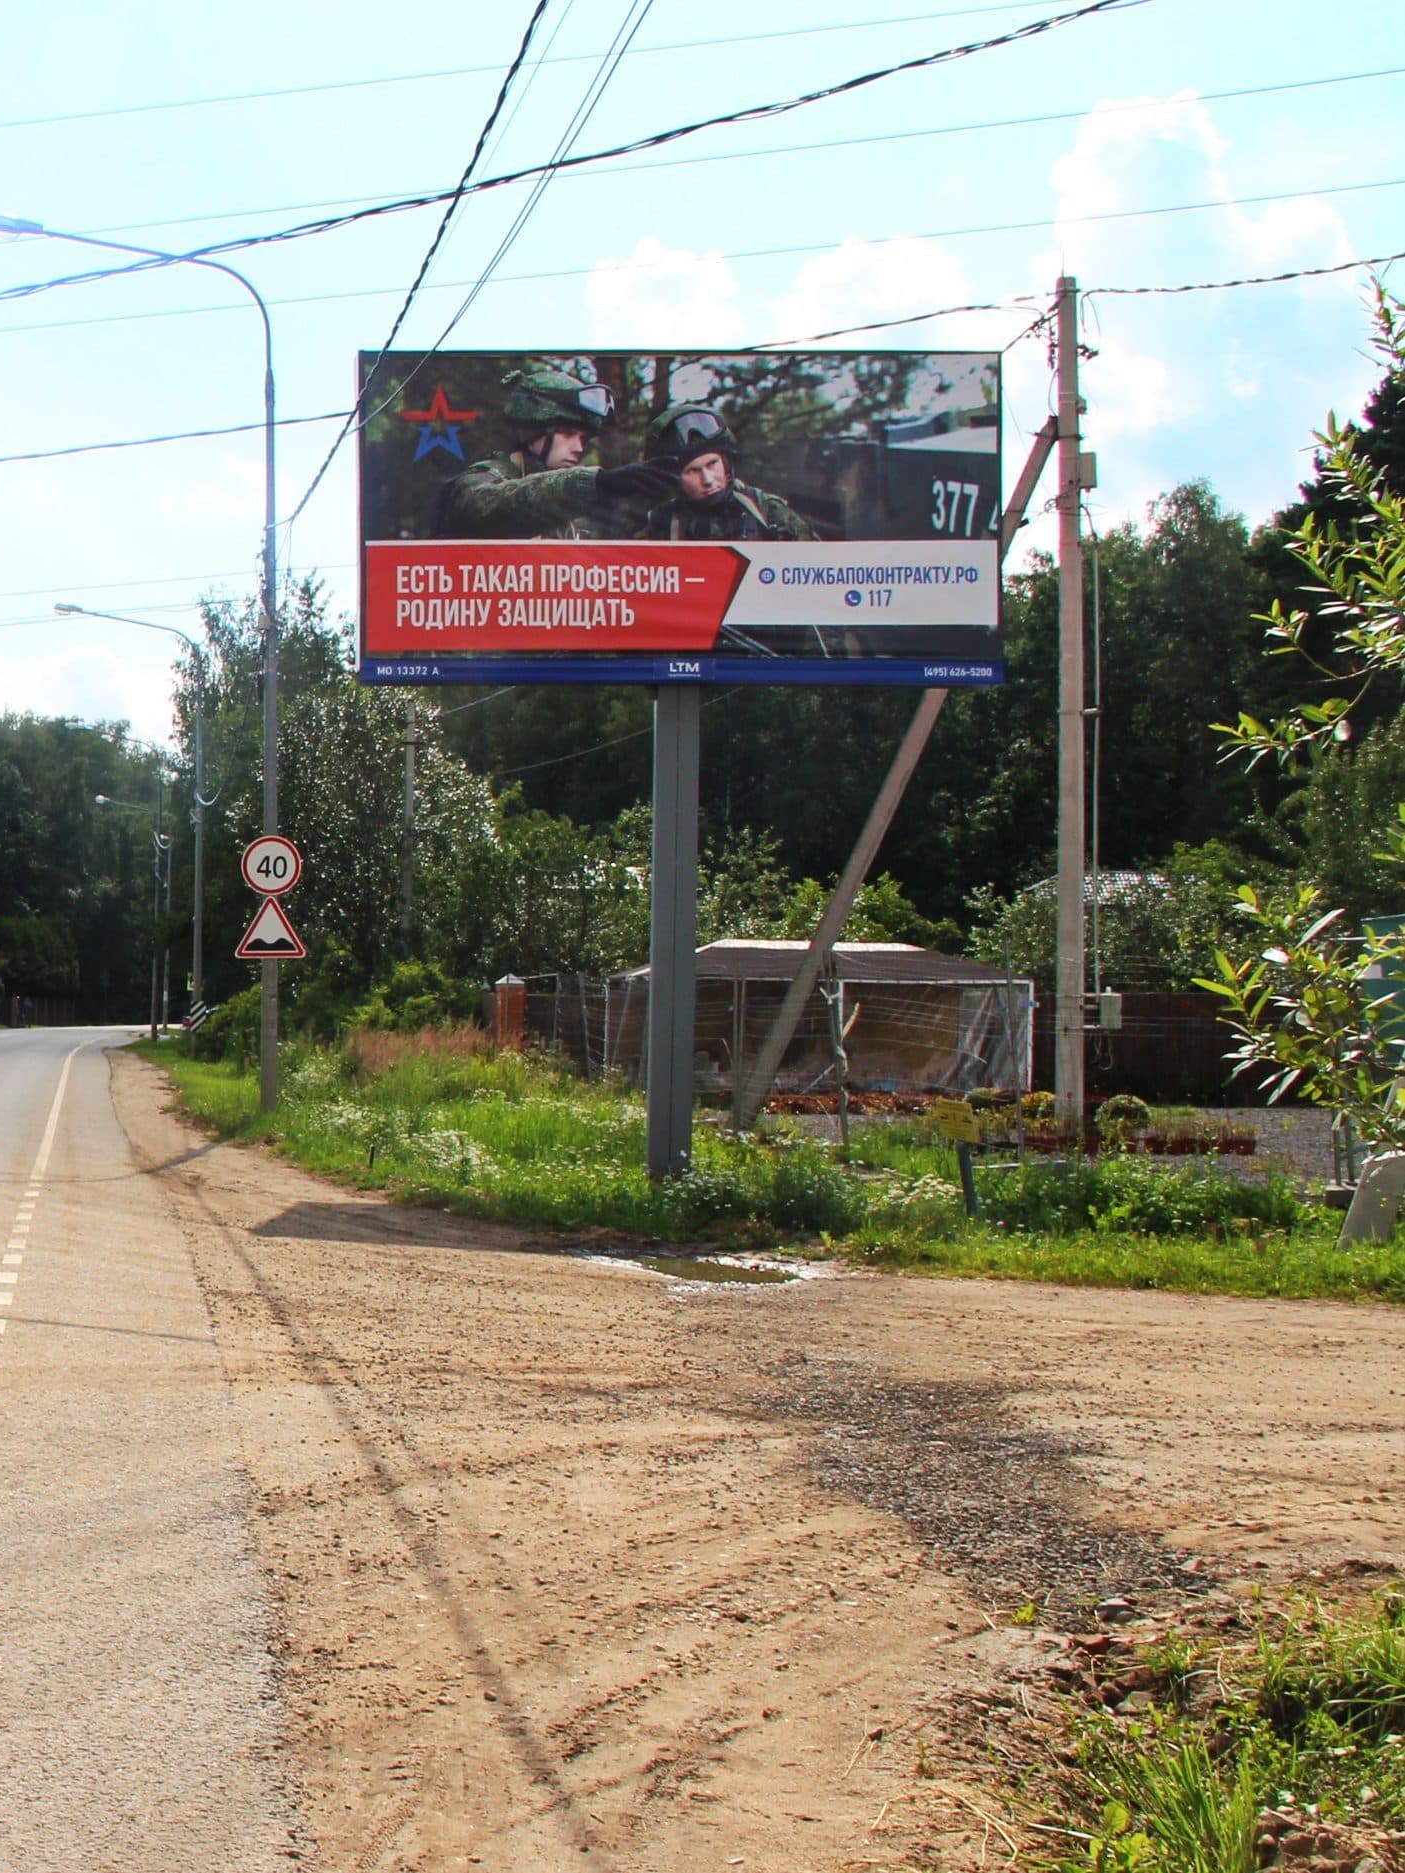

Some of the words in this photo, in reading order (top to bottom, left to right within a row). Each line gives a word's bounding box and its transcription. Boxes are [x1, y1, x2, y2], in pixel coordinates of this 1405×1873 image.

[932, 480, 979, 537] 377
[396, 564, 453, 594] ЕСТЬ
[458, 564, 534, 594] ТАКАЯ
[540, 564, 680, 594] ПРОФЕССИЯ
[781, 566, 978, 585] СЛУЖБАПОКОНТРАКТУ.РФ
[868, 589, 892, 607] 117
[396, 599, 491, 630] РОДИНУ
[498, 598, 635, 630] ЗАЩИЩАТЬ
[397, 666, 428, 676] 13372
[669, 662, 700, 673] LTM
[949, 667, 993, 677] 626-5200
[256, 856, 287, 879] 40
